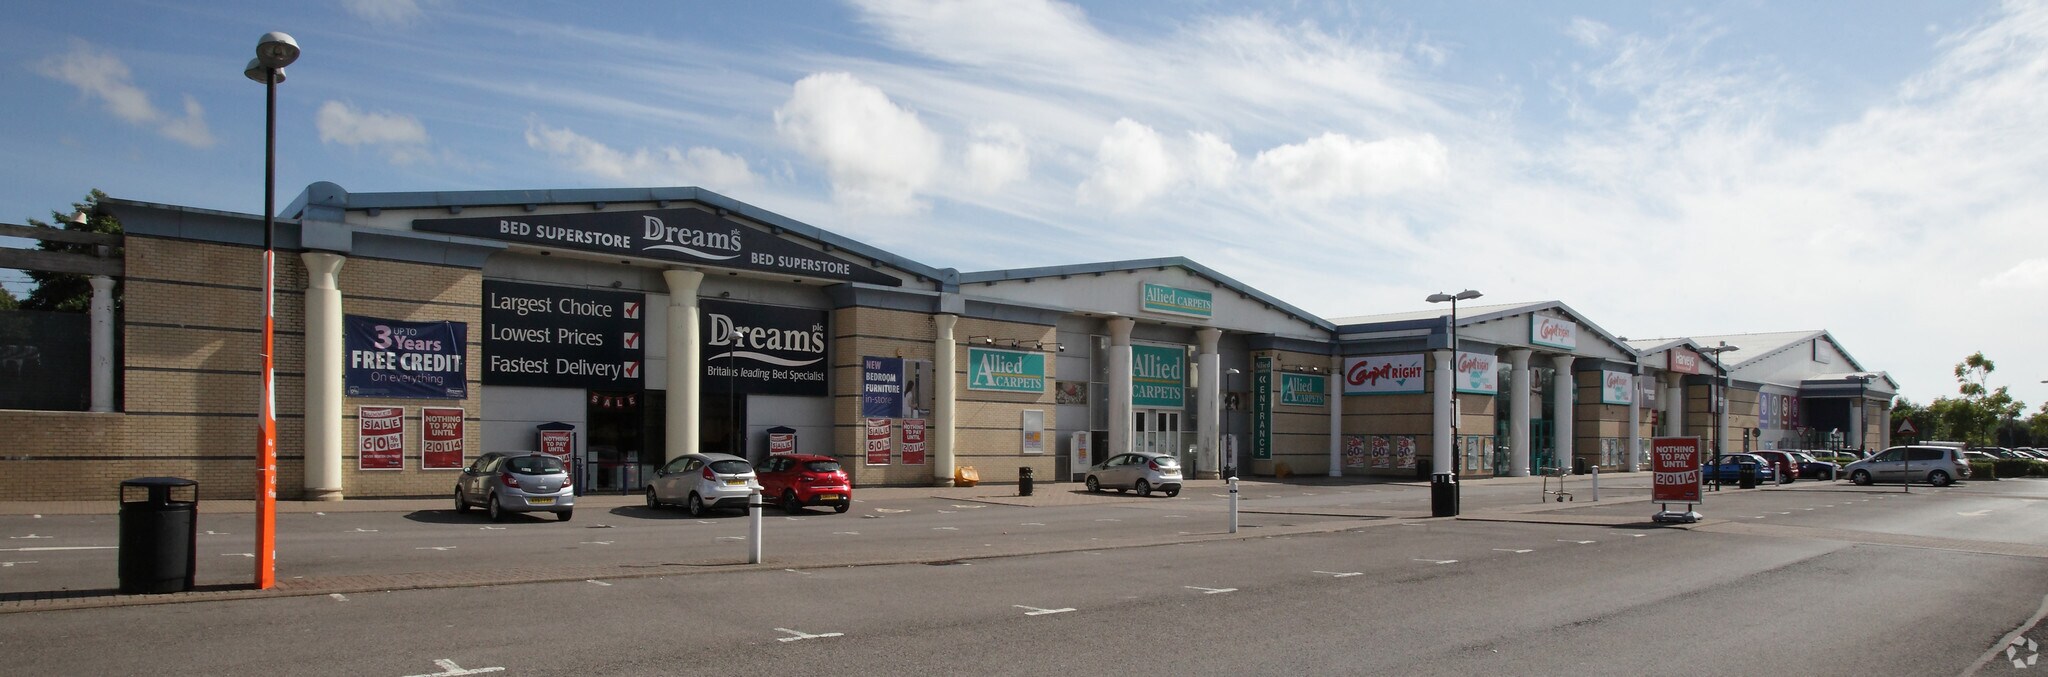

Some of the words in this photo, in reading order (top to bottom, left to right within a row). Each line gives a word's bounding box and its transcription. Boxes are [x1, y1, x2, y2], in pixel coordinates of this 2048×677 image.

[500, 220, 530, 236] BED
[536, 225, 630, 248] SUPERSTORE
[643, 215, 741, 252] Dreams
[731, 228, 740, 236] plc
[751, 252, 774, 265] BED
[778, 256, 850, 274] SUPERSTORE
[491, 292, 552, 316] Largest
[559, 298, 612, 317] Choice
[1146, 287, 1175, 304] Allied
[1177, 296, 1211, 309] CARPETS
[393, 328, 405, 336] UP
[406, 328, 417, 336] TO
[491, 324, 550, 343] Lowest
[558, 328, 603, 346] Prices
[708, 313, 825, 353] Dreams
[812, 323, 824, 332] plc
[374, 325, 392, 349] 3
[394, 335, 442, 351] Years
[352, 350, 396, 370] FREE
[400, 353, 461, 372] CREDIT
[491, 355, 548, 373] Fastest
[556, 358, 621, 380] Delivery
[866, 360, 881, 369] NEW
[1132, 353, 1181, 380] Allied
[1675, 351, 1695, 369] Harveys
[740, 367, 770, 381] leading
[773, 369, 787, 379] Bed
[790, 370, 824, 382] Specialist
[866, 372, 896, 382] BEDROOM
[973, 353, 1023, 386] Allied
[1347, 360, 1392, 386] Carpet
[371, 371, 387, 382] On
[389, 373, 444, 385] everything
[996, 376, 1041, 388] CARPETS
[866, 384, 900, 394] FURNITURE
[1132, 385, 1181, 400] CARPETS
[1284, 377, 1312, 402] Allied
[592, 395, 635, 407] SALE
[865, 395, 893, 404] in-store
[364, 418, 400, 429] SALE
[425, 415, 461, 423] NOTHING
[869, 427, 890, 435] SALE
[425, 441, 460, 450] 2014
[904, 443, 924, 452] 2014
[1657, 471, 1696, 484] 2014
